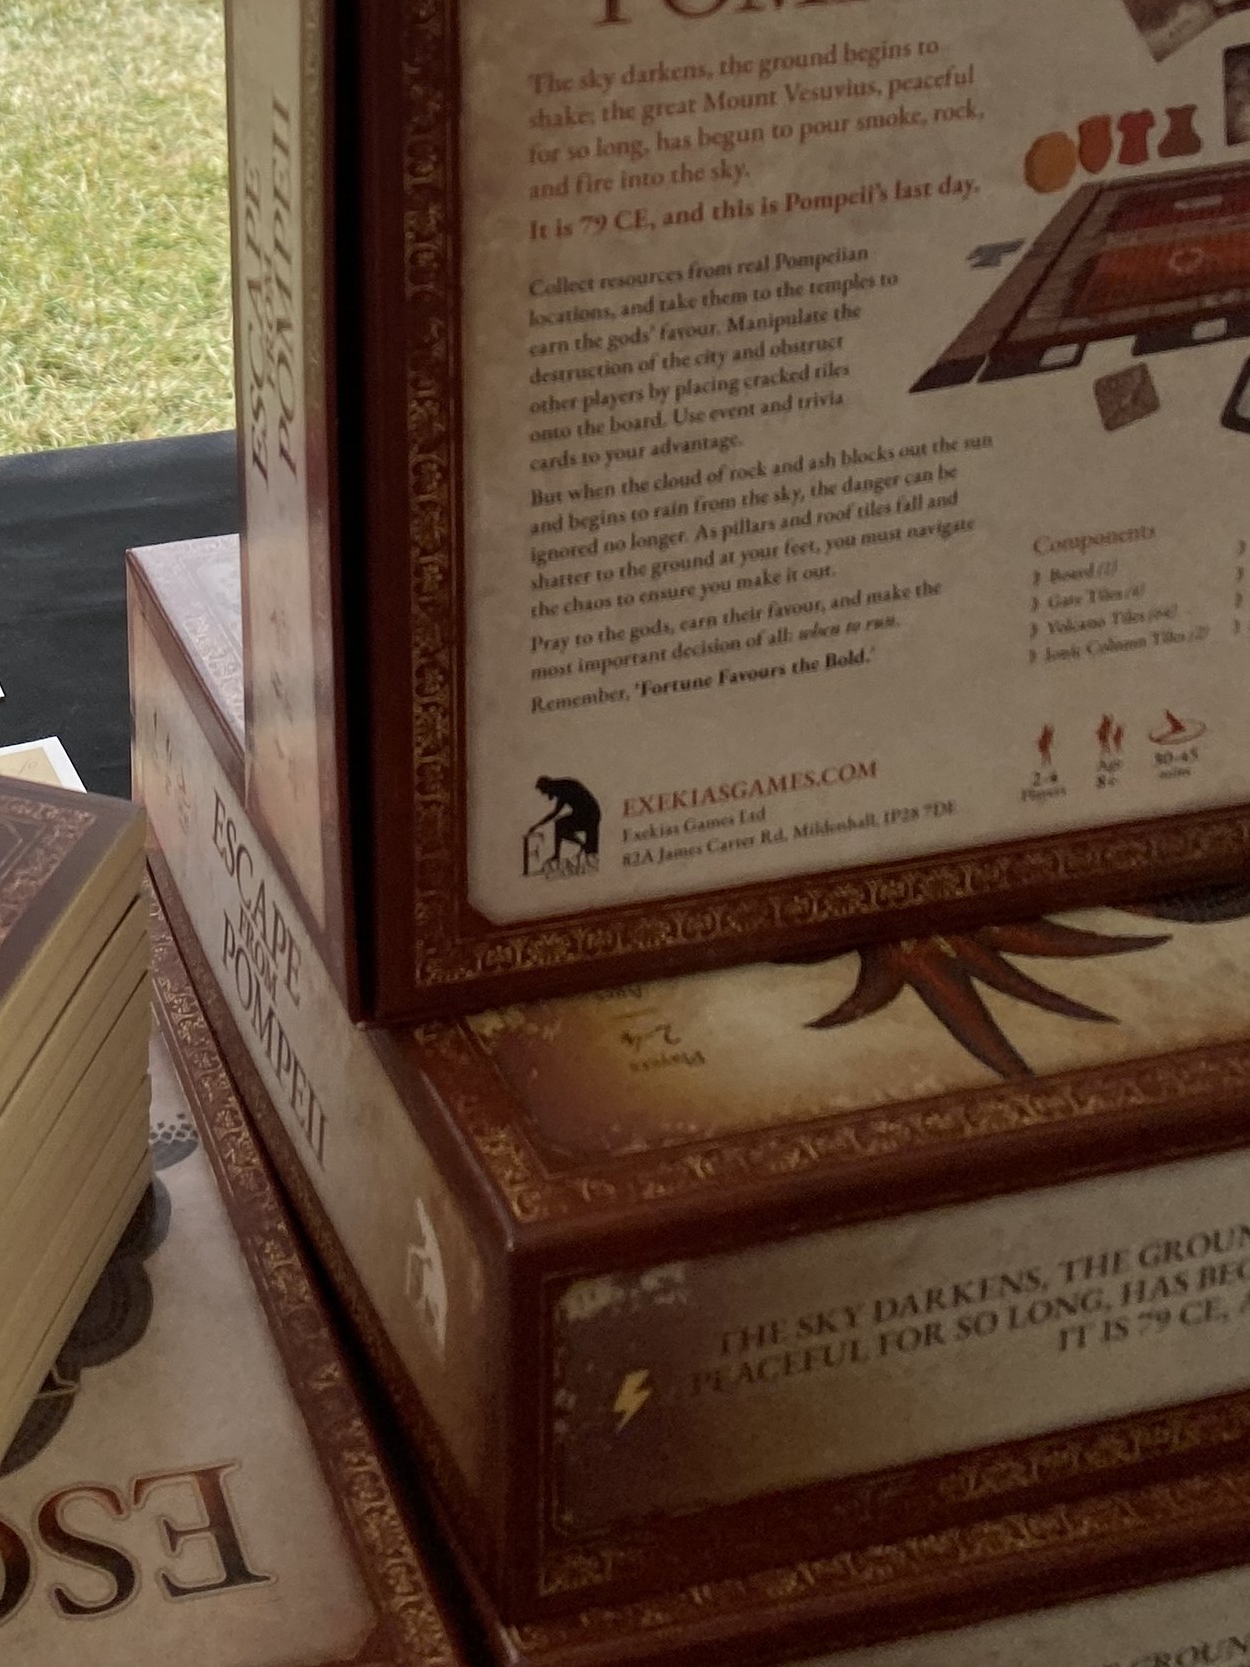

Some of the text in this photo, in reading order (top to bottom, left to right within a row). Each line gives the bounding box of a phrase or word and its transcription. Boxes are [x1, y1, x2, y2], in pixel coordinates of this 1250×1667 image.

[528, 40, 939, 96] The sky darkens, the ground begins to
[602, 101, 635, 123] the
[642, 98, 695, 127] great
[704, 90, 776, 113] Mount
[785, 78, 881, 104] Vesuvius,
[888, 64, 975, 101] peaceful
[528, 143, 561, 165] for
[568, 144, 590, 162] so
[597, 137, 649, 163] long,
[657, 131, 692, 152] has
[698, 127, 764, 153] begun
[772, 124, 793, 140] to
[800, 117, 848, 146] pour
[856, 108, 928, 132] smoke,
[528, 159, 749, 200] and fire into the sky.
[530, 219, 551, 241] It
[556, 218, 573, 239] is
[662, 202, 704, 227] and
[712, 198, 753, 221] this
[760, 196, 778, 217] is
[895, 182, 932, 201] last
[939, 175, 981, 201] day.
[272, 92, 297, 483] POMPEII
[529, 276, 594, 298] Collect
[600, 269, 684, 290] resources
[689, 260, 732, 280] from
[738, 254, 769, 275] real
[621, 295, 654, 318] and
[660, 292, 696, 314] take
[702, 287, 747, 308] them
[753, 288, 771, 302] to
[777, 280, 804, 299] the
[809, 272, 875, 298] temples
[880, 273, 898, 288] to
[244, 153, 269, 492] ESCAPE
[528, 340, 569, 358] earn
[575, 331, 602, 352] the
[727, 307, 827, 334] Manipulate
[833, 302, 862, 322] the
[530, 449, 576, 472] cards
[582, 452, 600, 467] to
[605, 446, 645, 468] your
[530, 489, 562, 508] But
[568, 482, 615, 501] when
[621, 476, 649, 496] the
[654, 468, 702, 492] cloud
[707, 464, 728, 485] of
[730, 460, 766, 482] rock
[772, 454, 804, 477] and
[809, 451, 836, 471] ash
[841, 444, 895, 467] blocks
[899, 443, 927, 459] out
[933, 435, 958, 455] the
[530, 600, 558, 619] the
[564, 595, 612, 615] chaos
[617, 594, 634, 608] to
[639, 585, 696, 604] ensure
[700, 579, 732, 602] you
[737, 568, 781, 591] make
[787, 567, 798, 584] it
[531, 686, 629, 715] Remember,
[718, 666, 786, 687] Favours
[792, 657, 819, 675] the
[623, 760, 878, 818] EXEKIASGAMES.COM
[622, 805, 766, 844] Exekias Games Ltd
[212, 787, 303, 1007] ESCAPE
[238, 907, 278, 1000] FROM
[222, 909, 327, 1171] POMPEII
[719, 1320, 789, 1357] THE
[797, 1304, 864, 1340] SKY
[872, 1267, 1051, 1325] DARKENS,
[1060, 1250, 1131, 1284] THE
[689, 1342, 873, 1398] PEACEFUL
[878, 1321, 946, 1357] FOR
[953, 1311, 999, 1341] SO
[1006, 1288, 1109, 1331] LONG,
[1119, 1272, 1189, 1307] HAS
[1057, 1324, 1088, 1352] IT
[1100, 1317, 1129, 1343] IS
